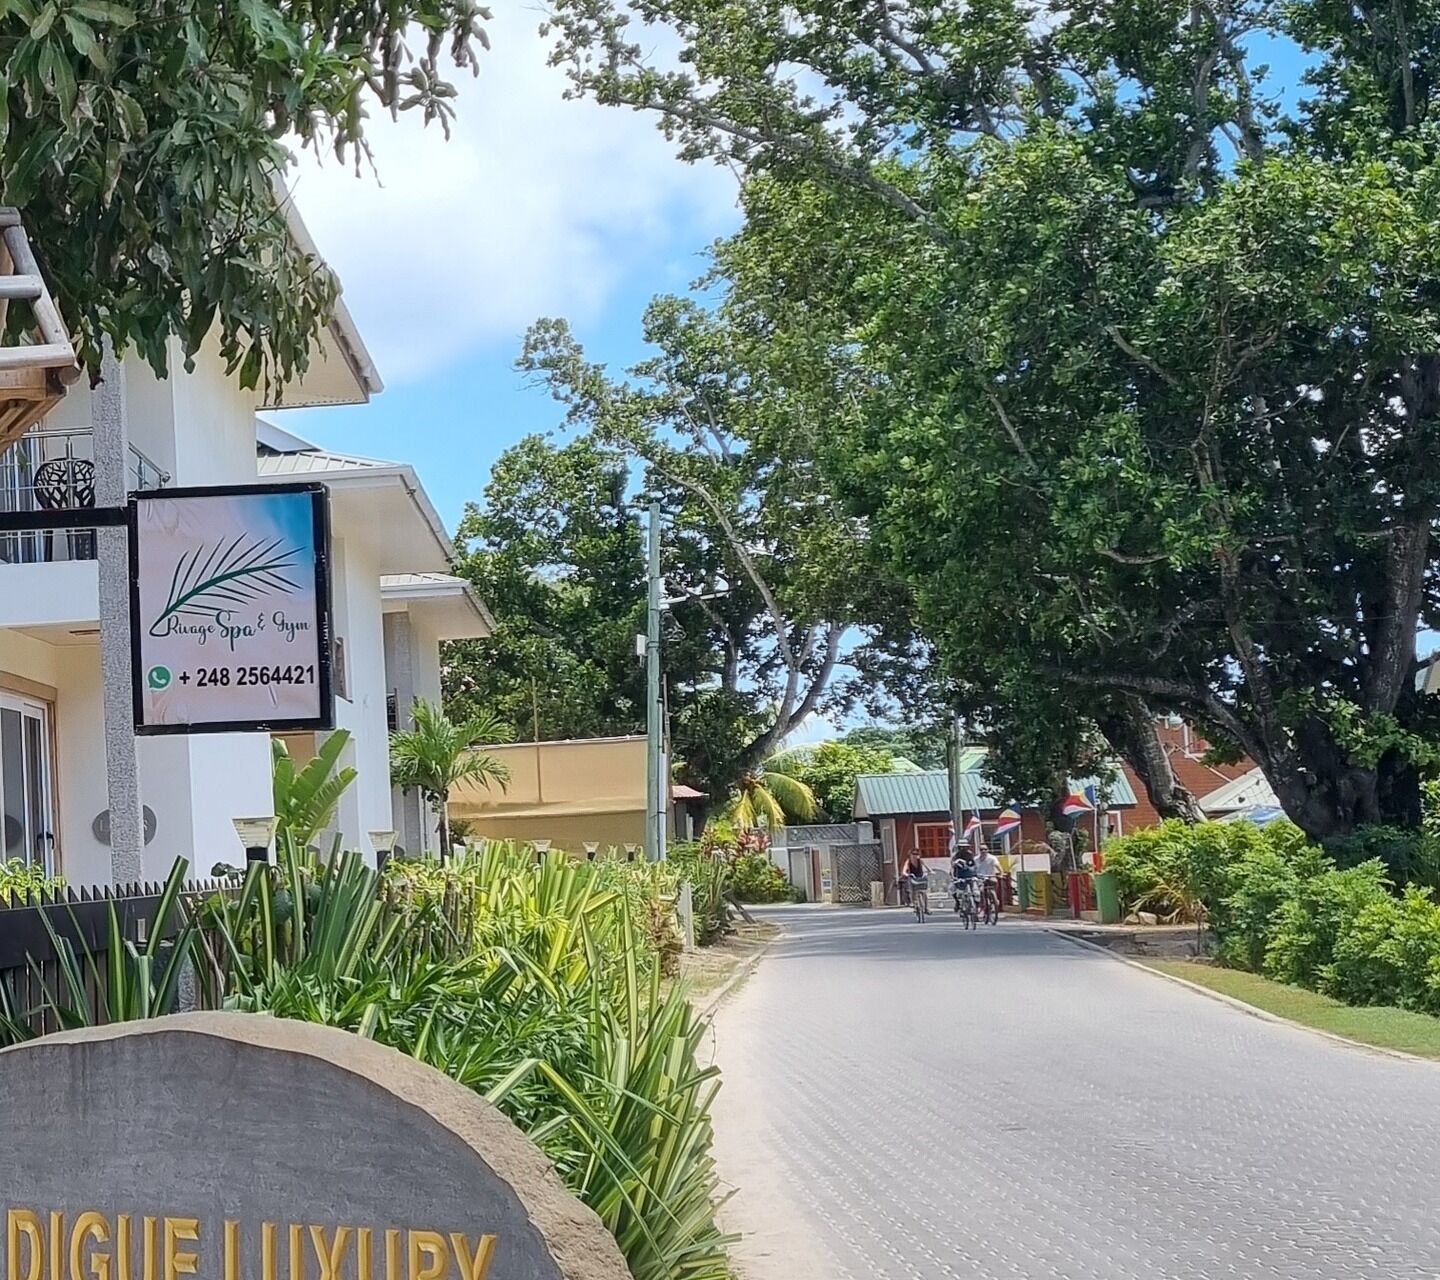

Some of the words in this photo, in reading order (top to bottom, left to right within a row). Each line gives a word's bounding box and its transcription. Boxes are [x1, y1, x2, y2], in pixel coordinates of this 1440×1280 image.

[215, 609, 256, 652] Spa
[257, 611, 266, 631] &
[272, 610, 310, 643] Gym
[178, 670, 191, 686] +
[196, 667, 231, 687] 248
[236, 664, 315, 686] 2564421
